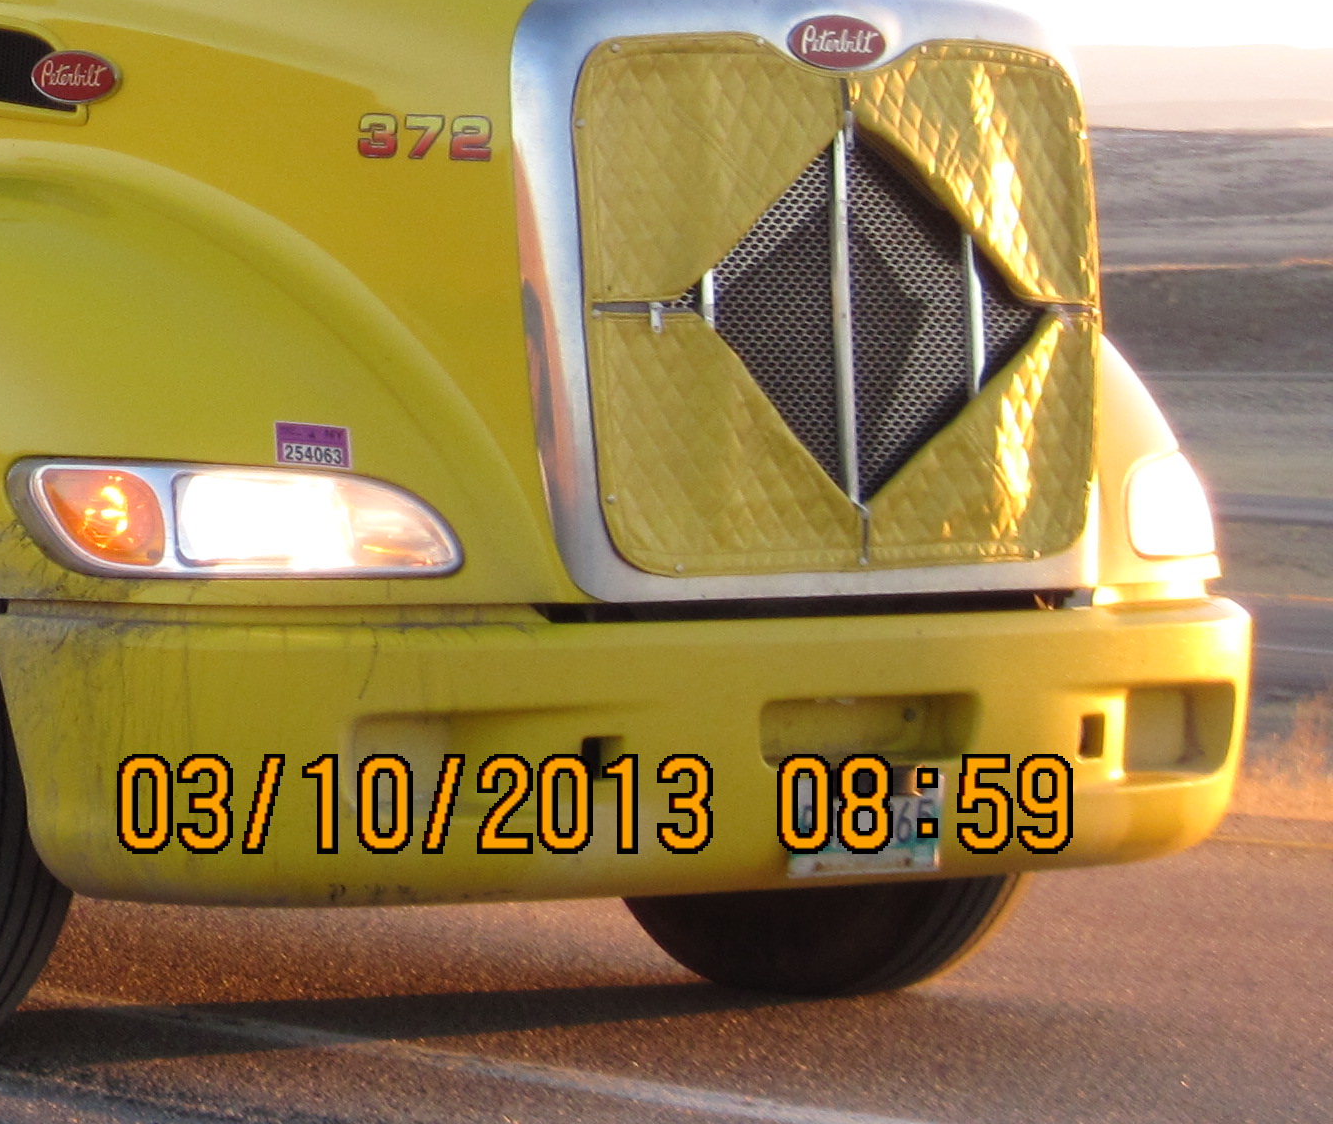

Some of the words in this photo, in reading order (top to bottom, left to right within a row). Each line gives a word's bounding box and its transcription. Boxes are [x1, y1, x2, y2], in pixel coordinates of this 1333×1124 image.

[801, 25, 879, 54] Peterbilt
[41, 60, 107, 87] Peterbilt
[358, 112, 493, 162] 372
[285, 443, 342, 464] 254063
